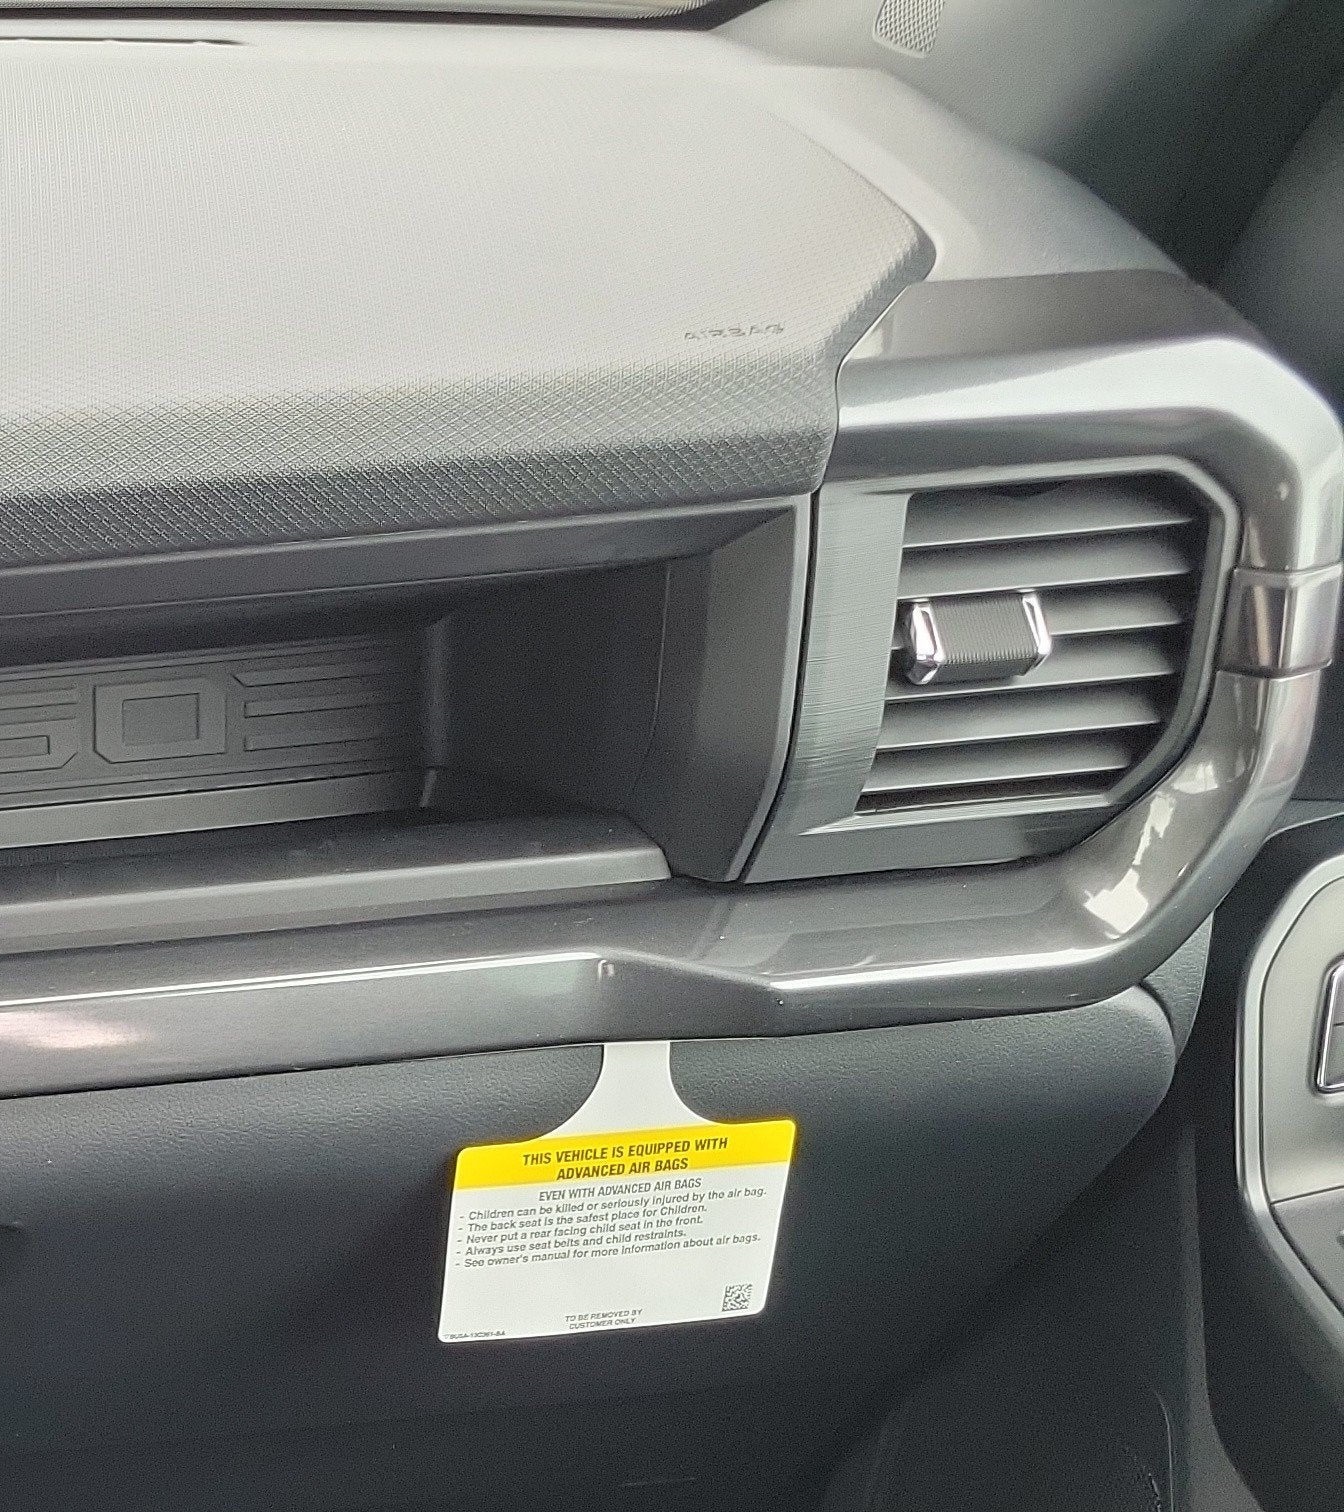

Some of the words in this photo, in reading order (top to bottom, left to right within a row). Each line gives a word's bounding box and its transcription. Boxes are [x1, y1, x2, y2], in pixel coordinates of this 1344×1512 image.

[522, 1151, 552, 1167] THIS
[555, 1146, 609, 1163] VEHICLE
[611, 1146, 625, 1158] IS
[627, 1140, 691, 1157] EQUIPPED
[694, 1137, 729, 1152] WITH
[556, 1163, 626, 1181] ADVANCED
[628, 1161, 651, 1175] AIR
[654, 1157, 689, 1172] BAGS
[468, 1205, 515, 1221] Children
[516, 1207, 537, 1218] can
[539, 1204, 553, 1215] be
[555, 1201, 584, 1213] killed
[586, 1201, 599, 1211] or
[600, 1195, 649, 1211] seriously
[652, 1192, 690, 1206] injured
[691, 1191, 706, 1204] by
[707, 1190, 725, 1200] the
[727, 1188, 742, 1198] air
[743, 1186, 767, 1198] bag.
[538, 1190, 566, 1202] EVEN
[568, 1187, 595, 1199] WITH
[597, 1182, 652, 1197] ADVANCED
[653, 1181, 672, 1192] AIR
[674, 1178, 703, 1190] BAGS
[465, 1233, 498, 1245] Never
[499, 1230, 519, 1244] put
[520, 1231, 528, 1241] a
[529, 1228, 551, 1240] rear
[553, 1225, 588, 1239] facing
[589, 1222, 616, 1234] child
[618, 1220, 641, 1231] seat
[643, 1219, 654, 1230] in
[655, 1217, 674, 1228] the
[675, 1215, 704, 1226] front.
[467, 1222, 489, 1232] The
[490, 1219, 516, 1231] back
[518, 1217, 542, 1228] seat
[544, 1215, 554, 1226] is
[556, 1214, 574, 1225] the
[576, 1211, 609, 1223] safest
[610, 1210, 640, 1223] place
[642, 1206, 658, 1217] for
[660, 1203, 708, 1216] Children.
[463, 1257, 485, 1268] See
[486, 1253, 529, 1267] owner's
[530, 1249, 571, 1263] manual
[572, 1247, 589, 1259] for
[590, 1247, 619, 1258] more
[620, 1240, 682, 1256] information
[682, 1236, 714, 1249] about
[715, 1235, 731, 1246] air
[732, 1232, 762, 1245] bags.
[465, 1244, 505, 1257] Always
[506, 1242, 526, 1252] use
[528, 1239, 552, 1250] seat
[553, 1236, 580, 1248] belts
[582, 1235, 604, 1246] and
[605, 1233, 632, 1244] child
[633, 1229, 687, 1242] restraints.
